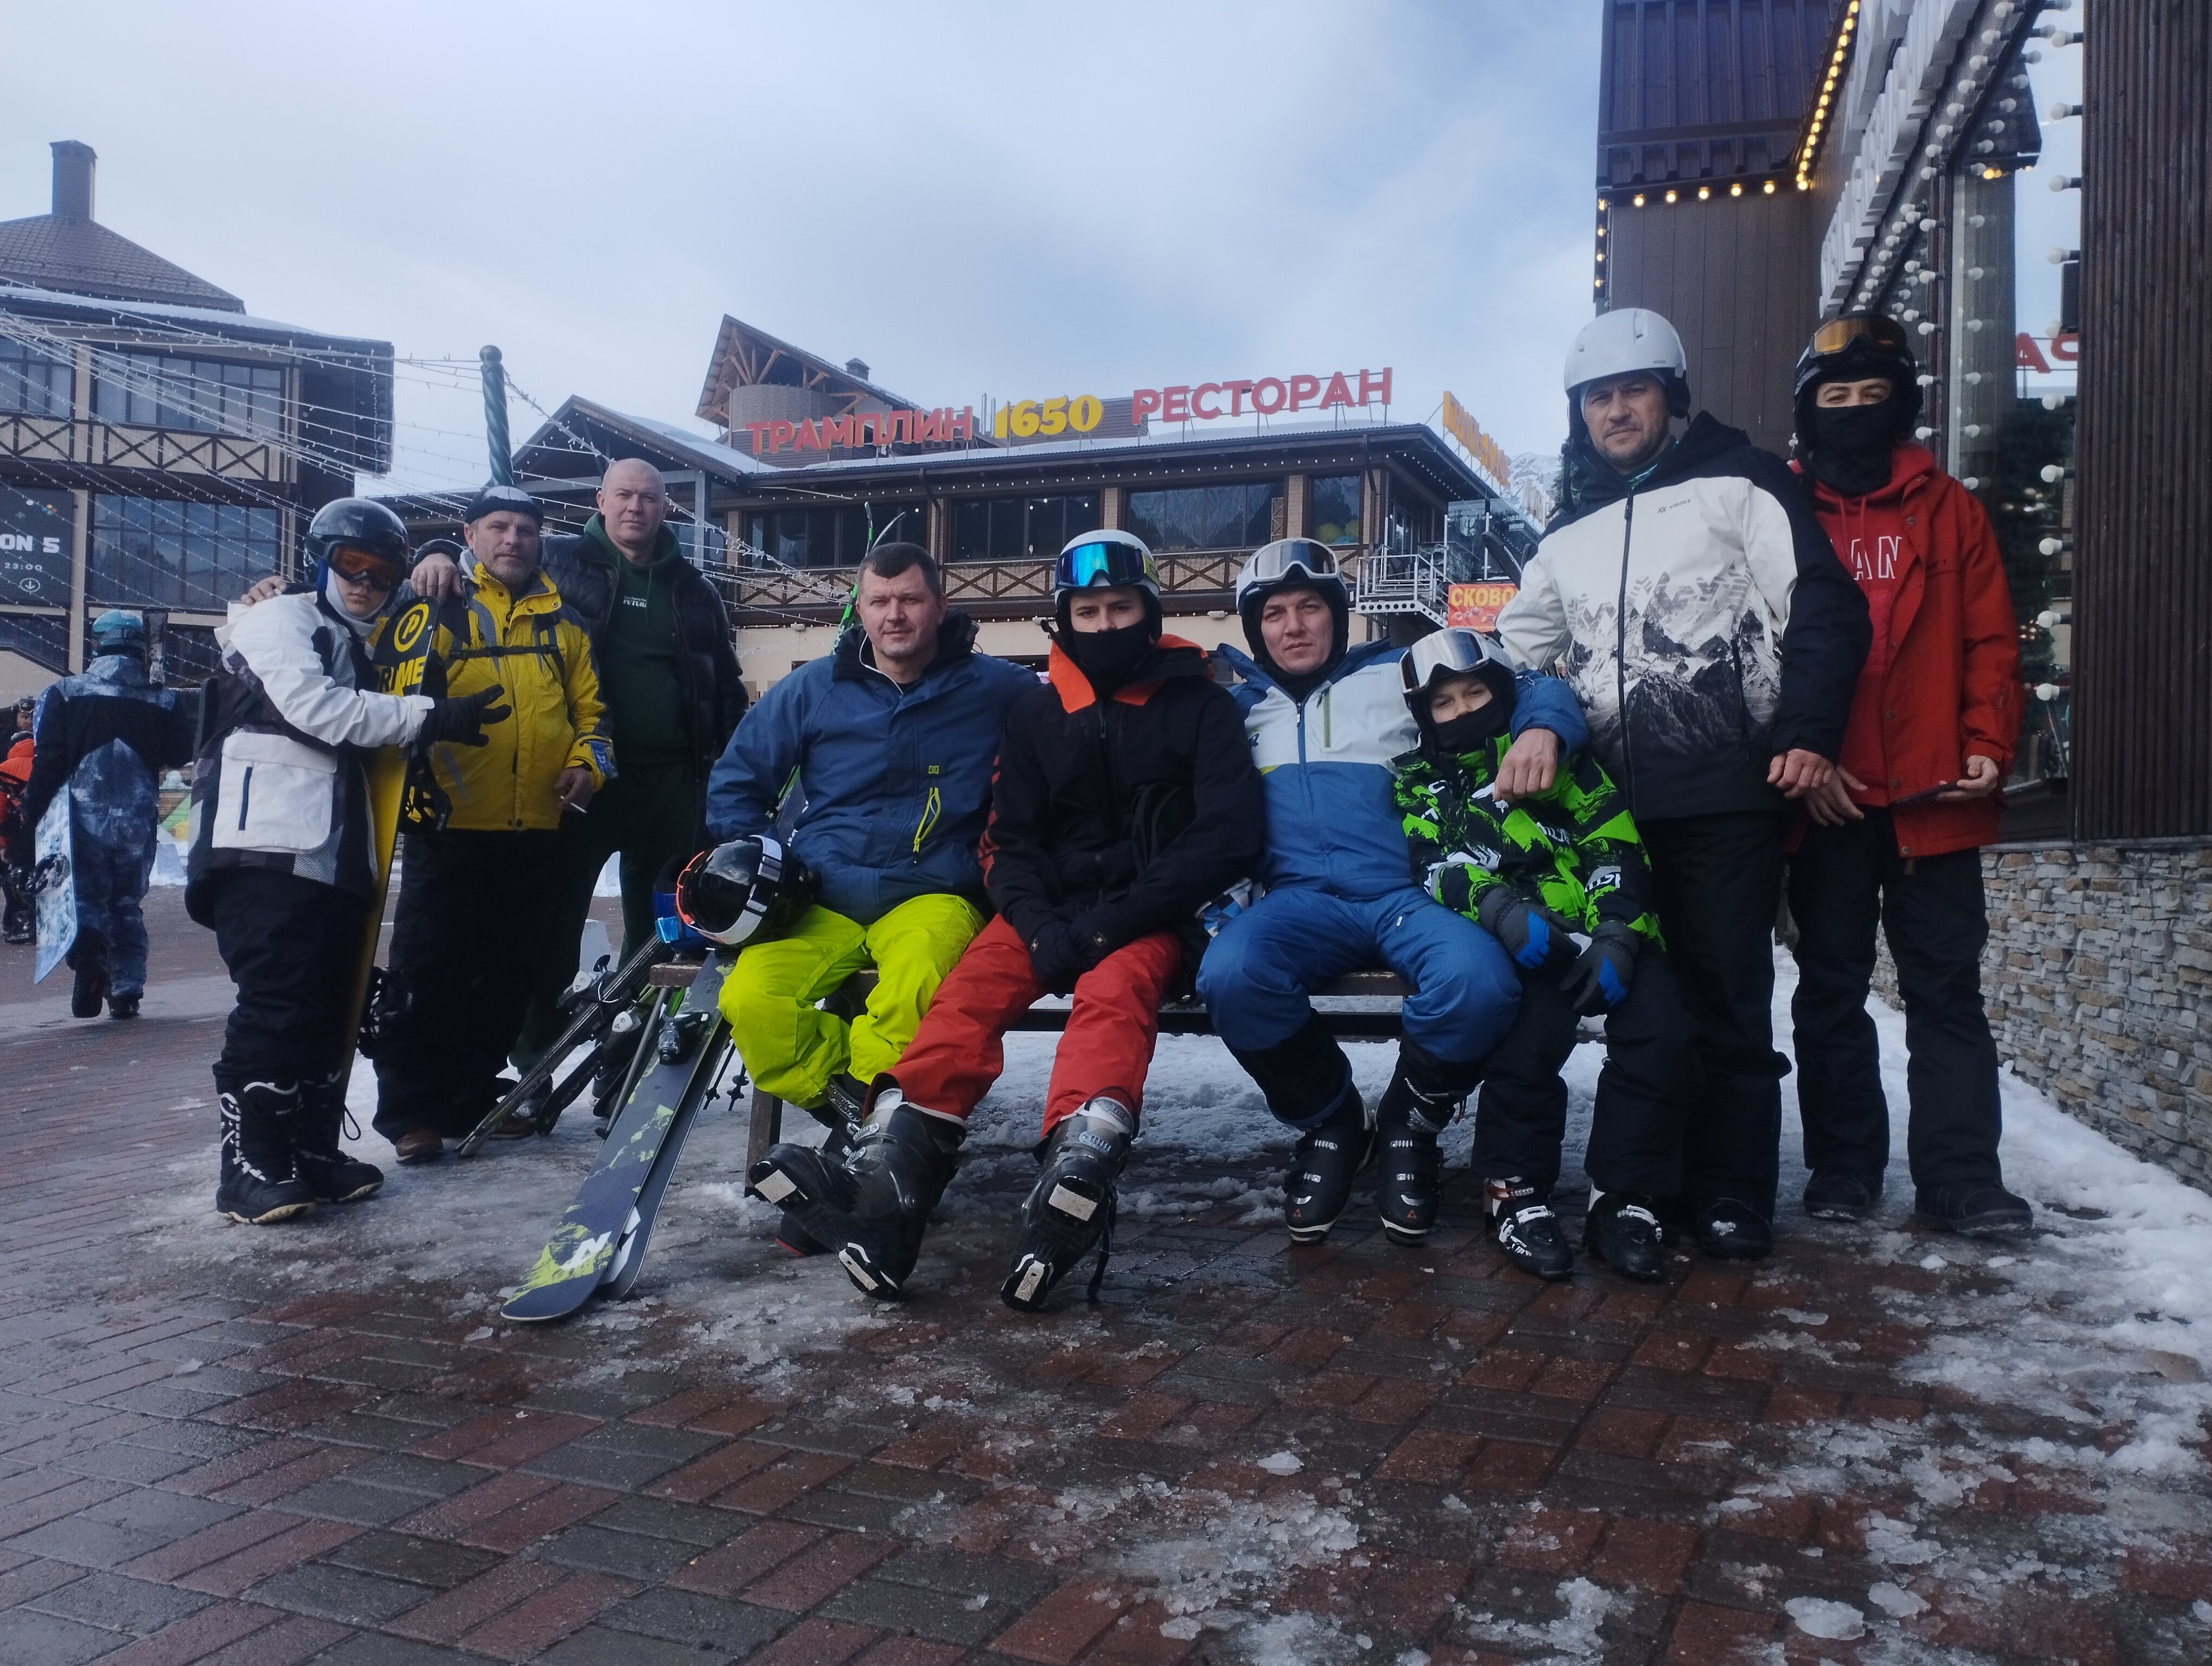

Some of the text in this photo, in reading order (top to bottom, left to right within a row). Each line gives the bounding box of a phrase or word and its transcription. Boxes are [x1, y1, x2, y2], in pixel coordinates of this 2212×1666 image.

[745, 367, 1392, 454] ТРАМПЛИН 1650 РЕСТОРАН
[0, 534, 60, 553] ON 5
[1829, 536, 1902, 580] AN
[4, 562, 42, 571] 23:00
[374, 656, 426, 692] RIME
[1405, 1078, 1435, 1104] FISCHER
